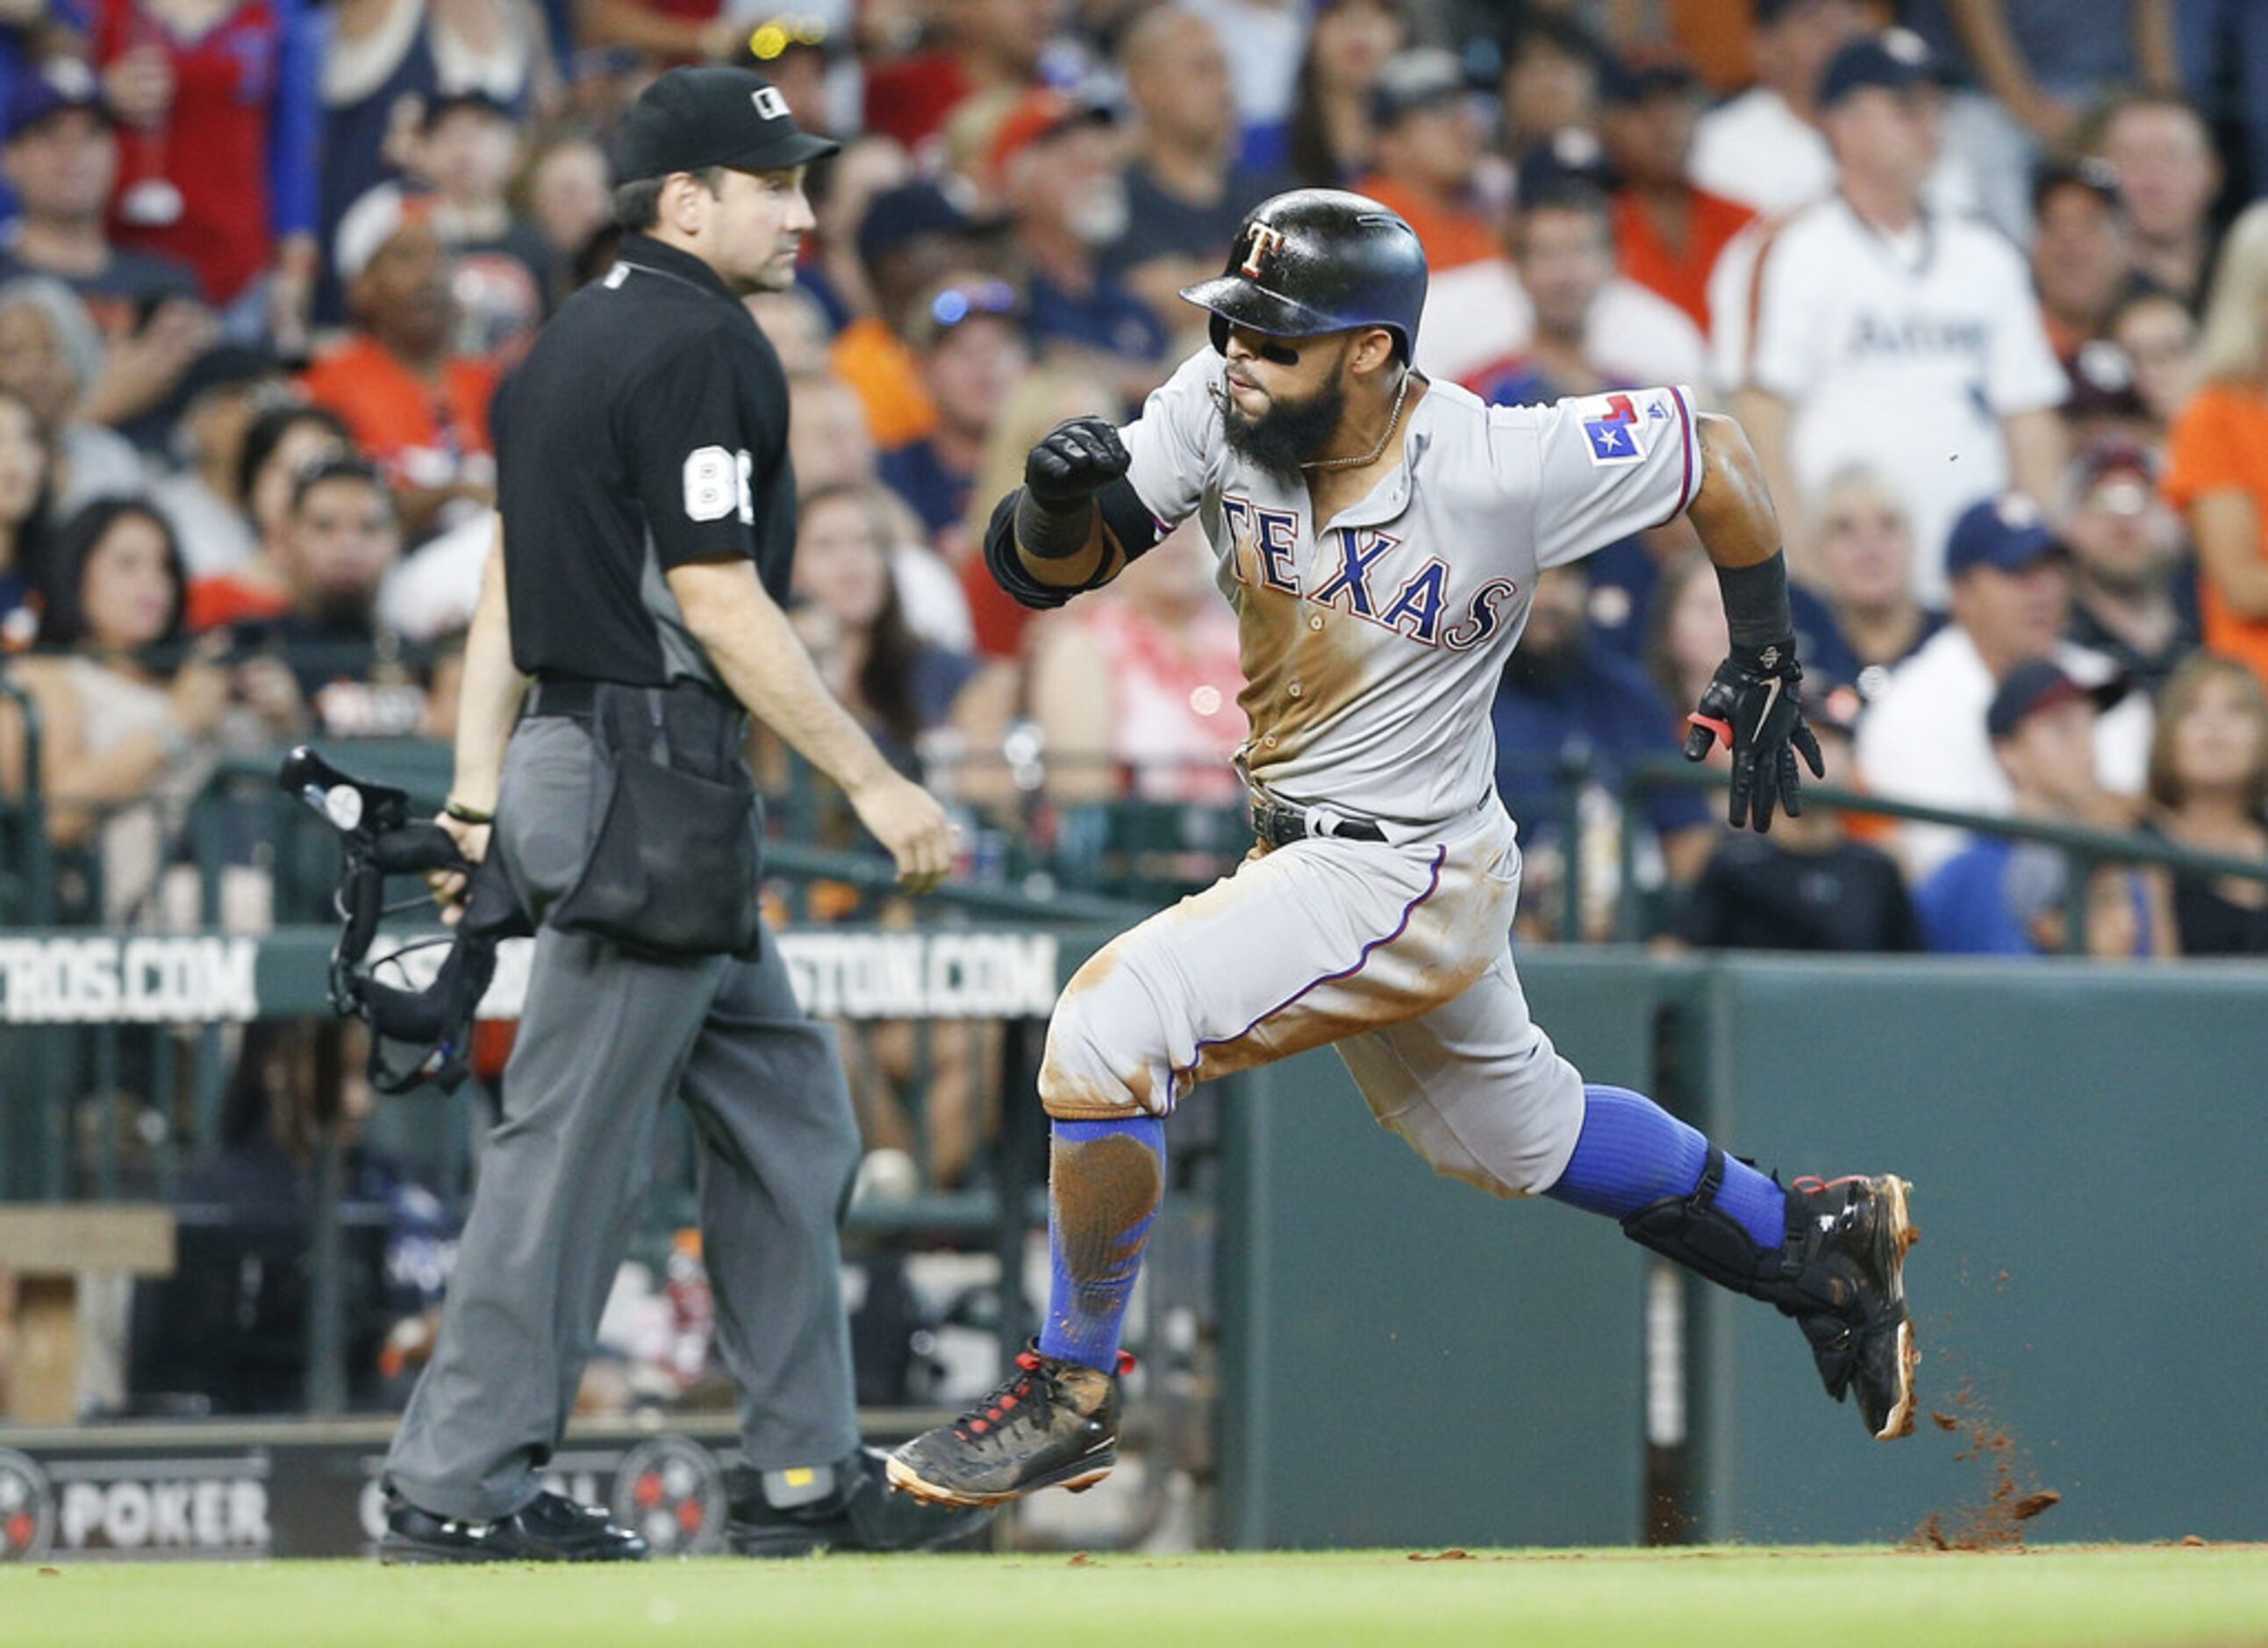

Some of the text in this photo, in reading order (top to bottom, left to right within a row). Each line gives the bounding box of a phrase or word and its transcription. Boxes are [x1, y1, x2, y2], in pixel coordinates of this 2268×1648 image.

[1241, 221, 1284, 279] T
[1220, 492, 1518, 651] TEXAS
[0, 935, 260, 1022] ROS.COM
[61, 1479, 271, 1547] POKER
